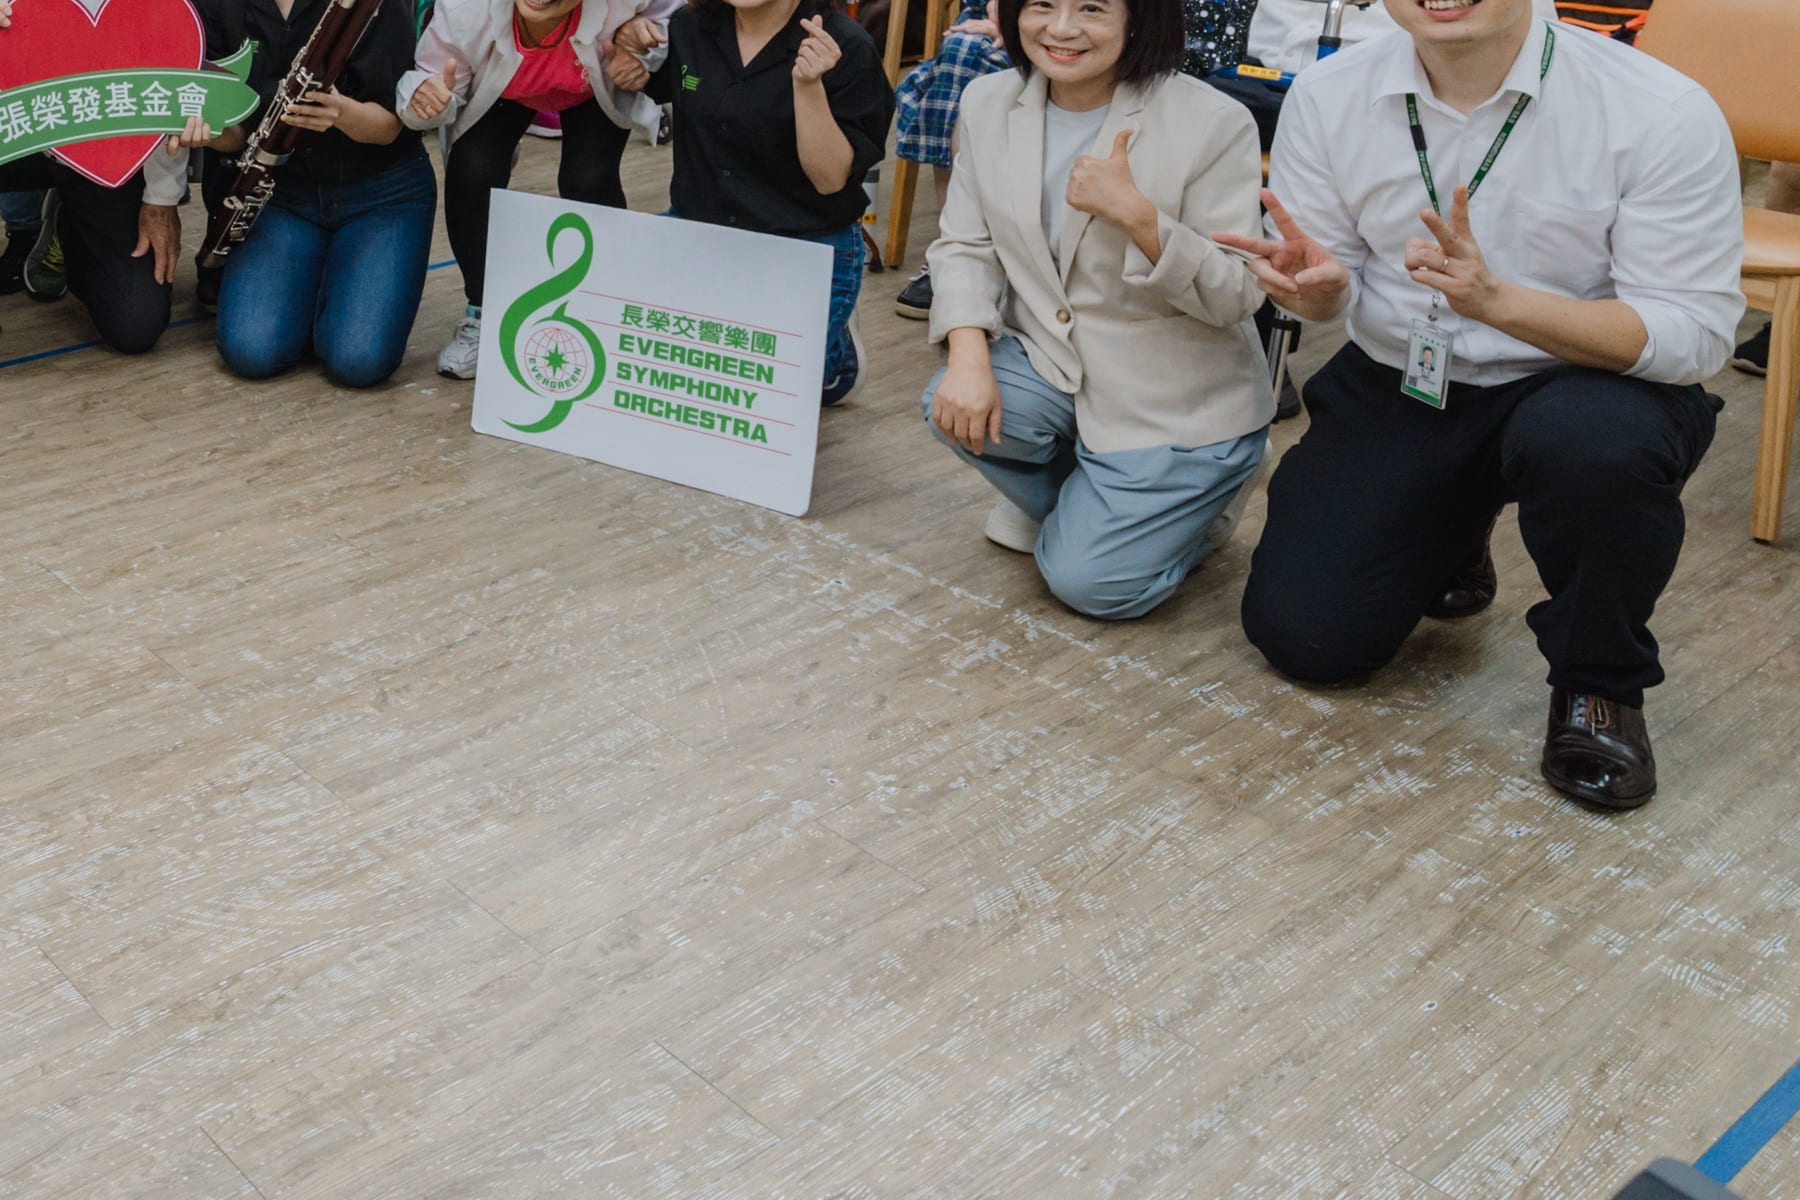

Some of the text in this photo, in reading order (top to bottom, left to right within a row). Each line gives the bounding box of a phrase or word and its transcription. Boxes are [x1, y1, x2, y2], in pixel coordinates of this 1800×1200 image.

[621, 304, 777, 358] 長榮交響樂團
[529, 357, 581, 389] EVERGREEN
[619, 333, 774, 384] EVERGREEN
[616, 361, 759, 410] SYMPHONY
[614, 389, 768, 443] ORCHESTRA
